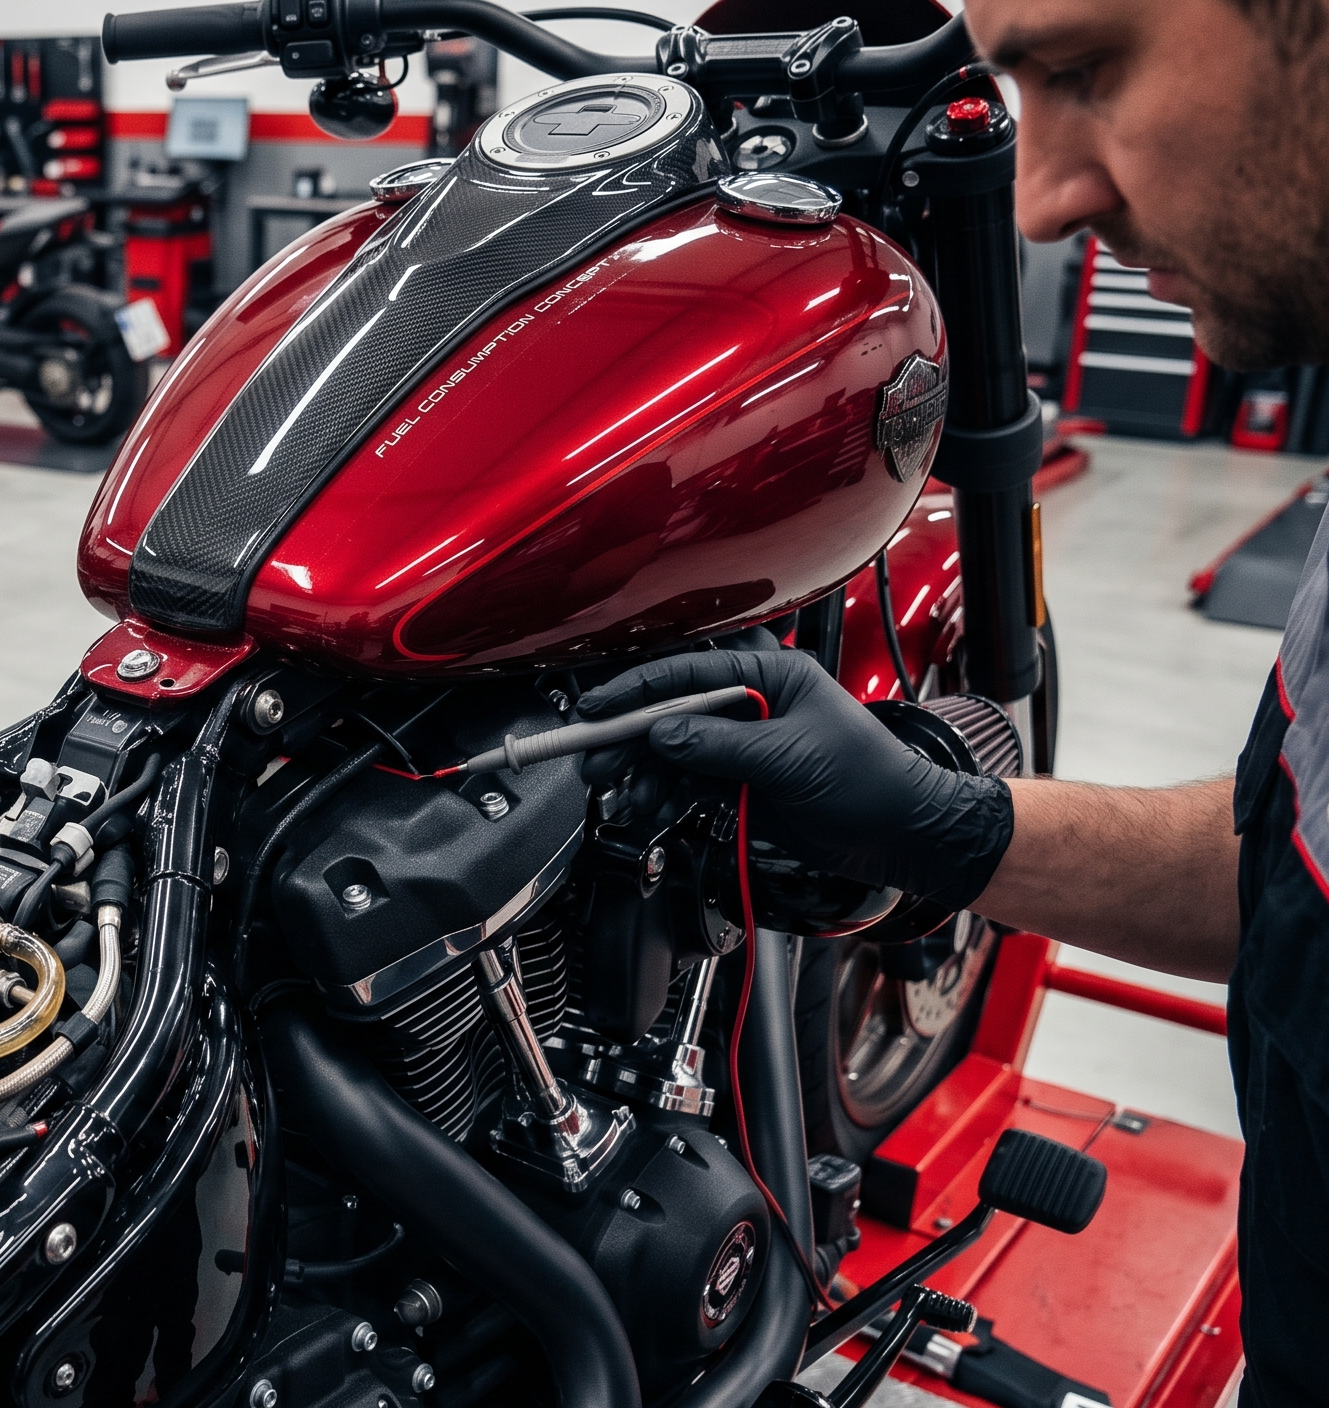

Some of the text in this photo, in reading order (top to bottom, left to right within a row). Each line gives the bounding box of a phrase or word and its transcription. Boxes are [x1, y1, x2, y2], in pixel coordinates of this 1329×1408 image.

[375, 258, 610, 458] FUEL CONSUMPTION CONCEPT
